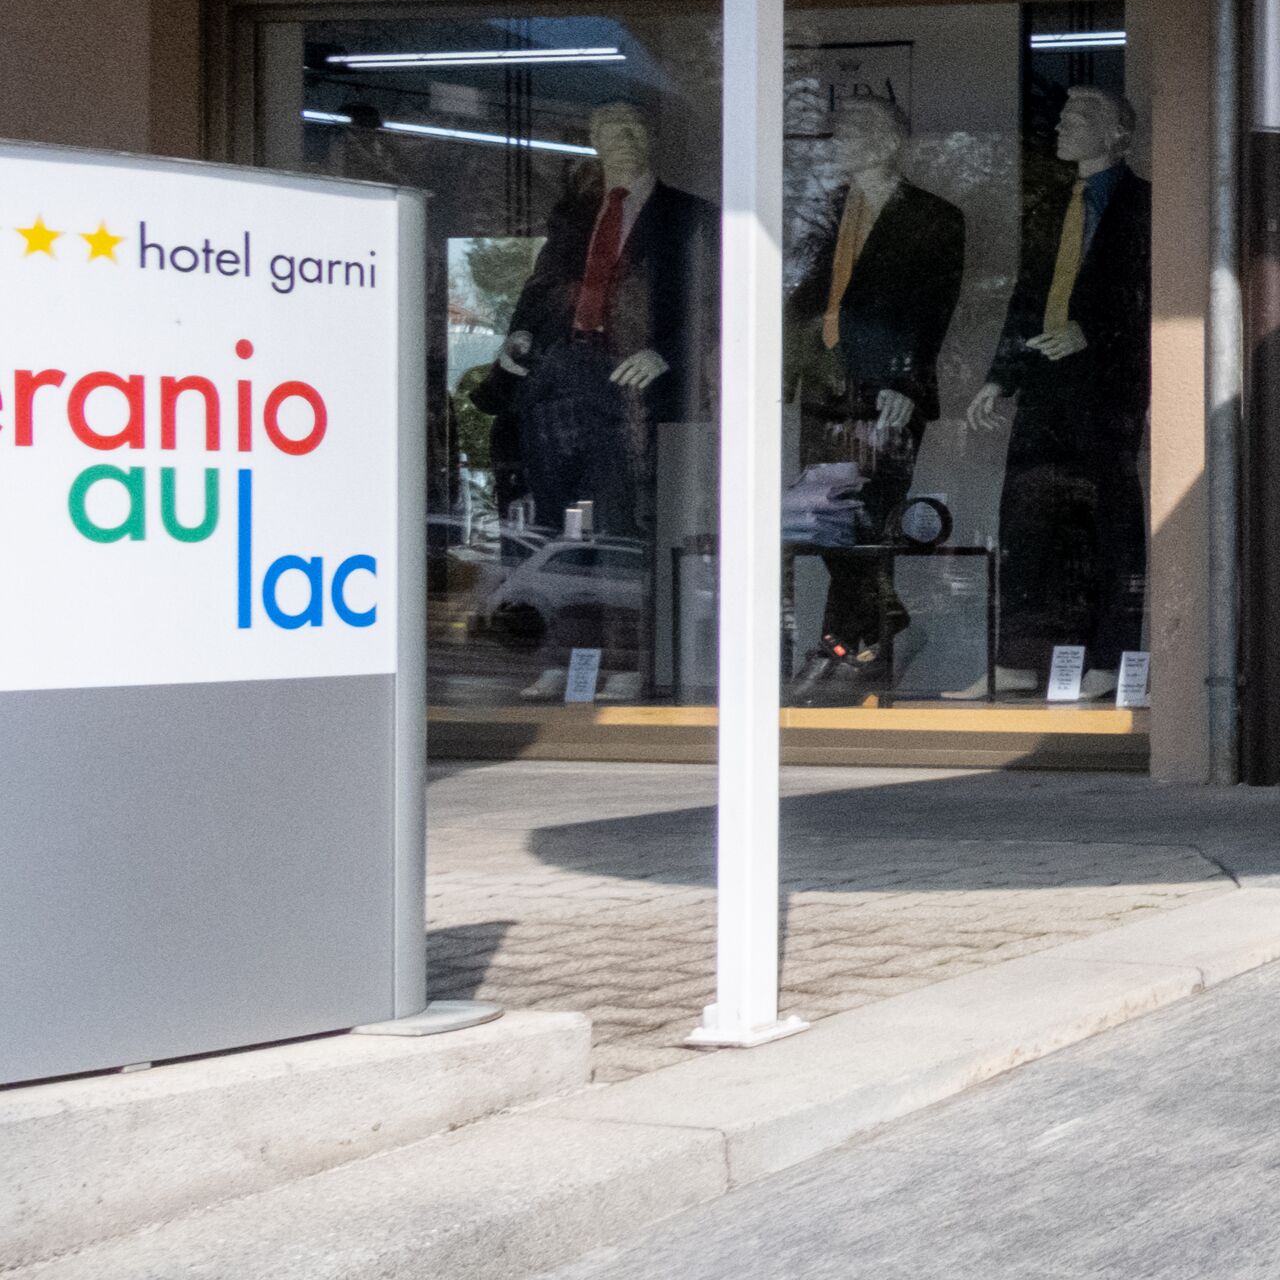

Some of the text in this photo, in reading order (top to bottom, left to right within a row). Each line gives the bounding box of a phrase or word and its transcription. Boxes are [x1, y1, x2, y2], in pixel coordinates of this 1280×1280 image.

[139, 221, 377, 294] hotel garni
[0, 338, 328, 456] ranio
[68, 463, 220, 544] au
[237, 468, 377, 629] lac
